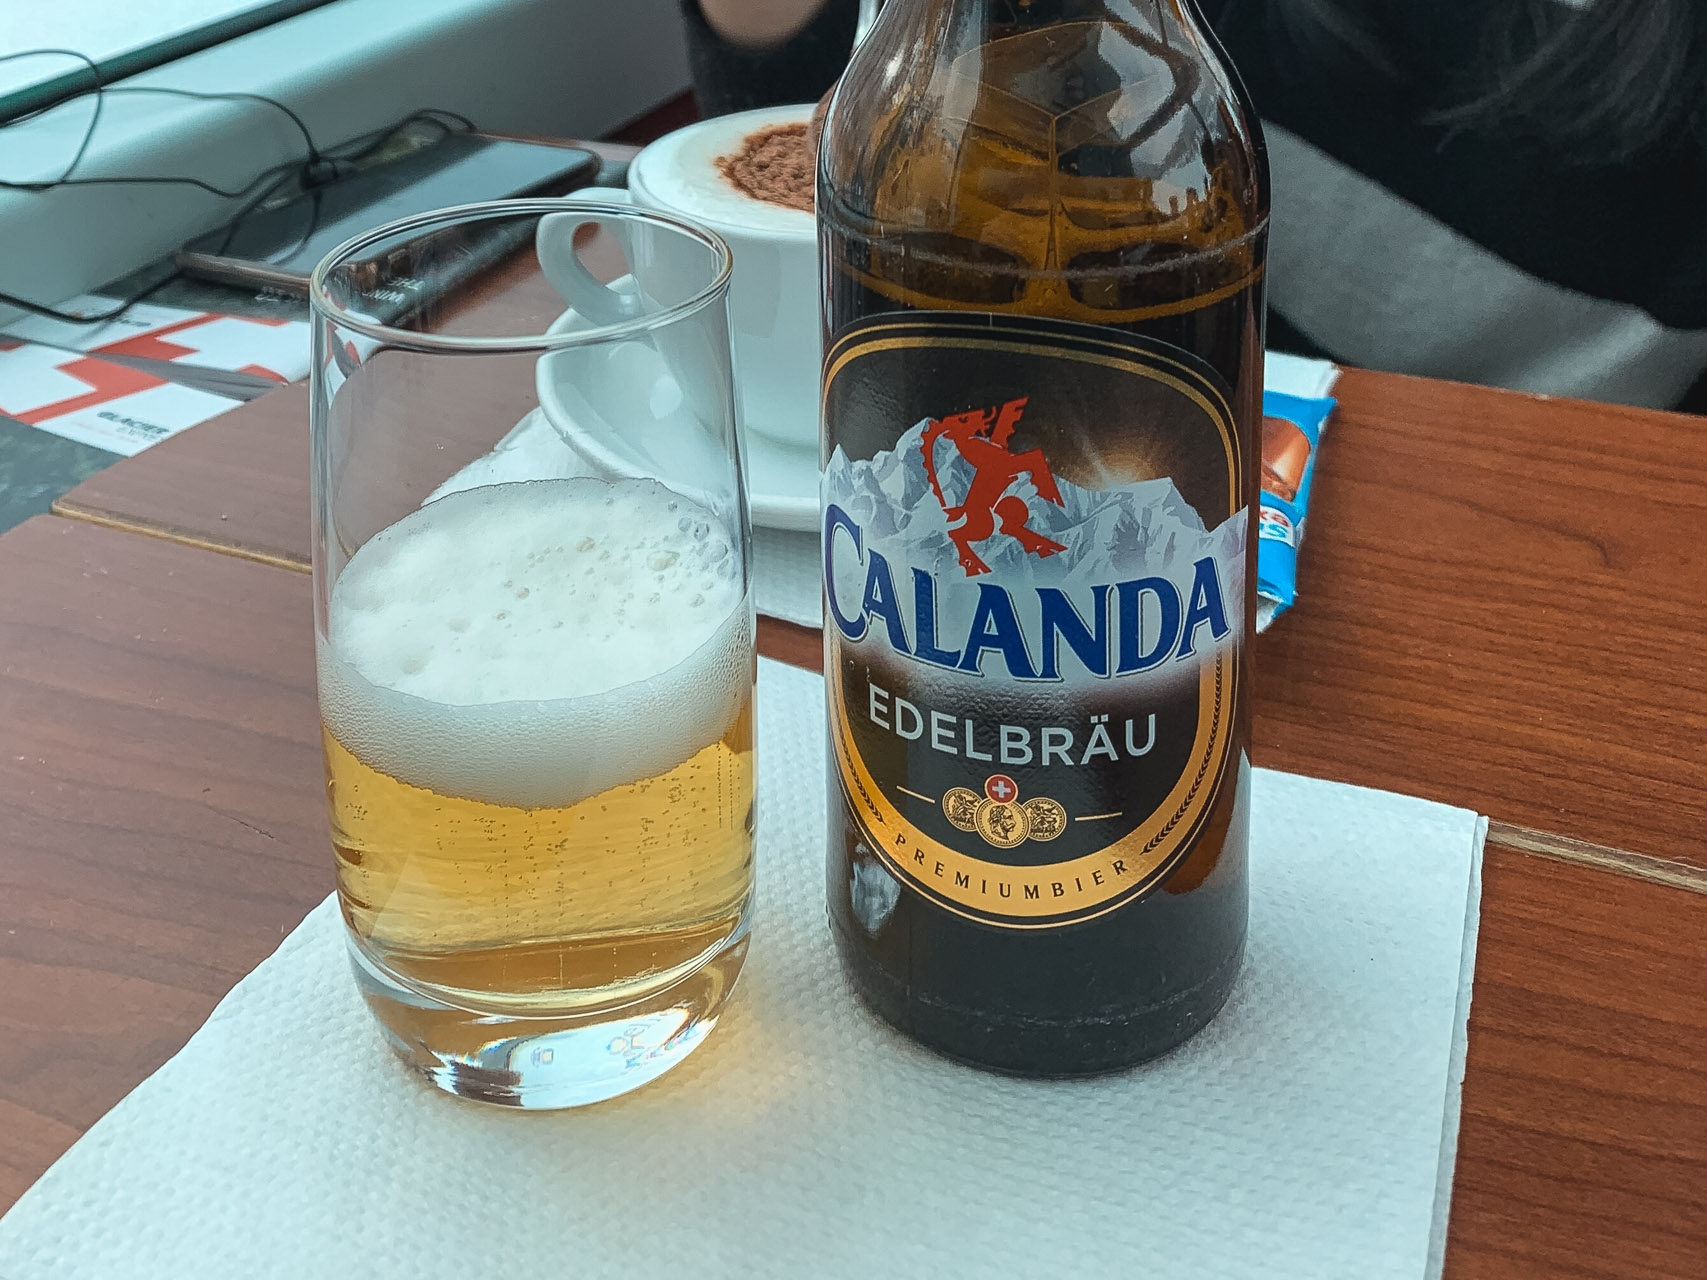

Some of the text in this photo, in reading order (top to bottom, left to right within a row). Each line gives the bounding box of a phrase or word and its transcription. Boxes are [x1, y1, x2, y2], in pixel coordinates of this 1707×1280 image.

[823, 502, 1231, 683] CALANDA
[867, 683, 1157, 766] EDELBRÄU
[894, 833, 1129, 900] PREMIUMBIER
